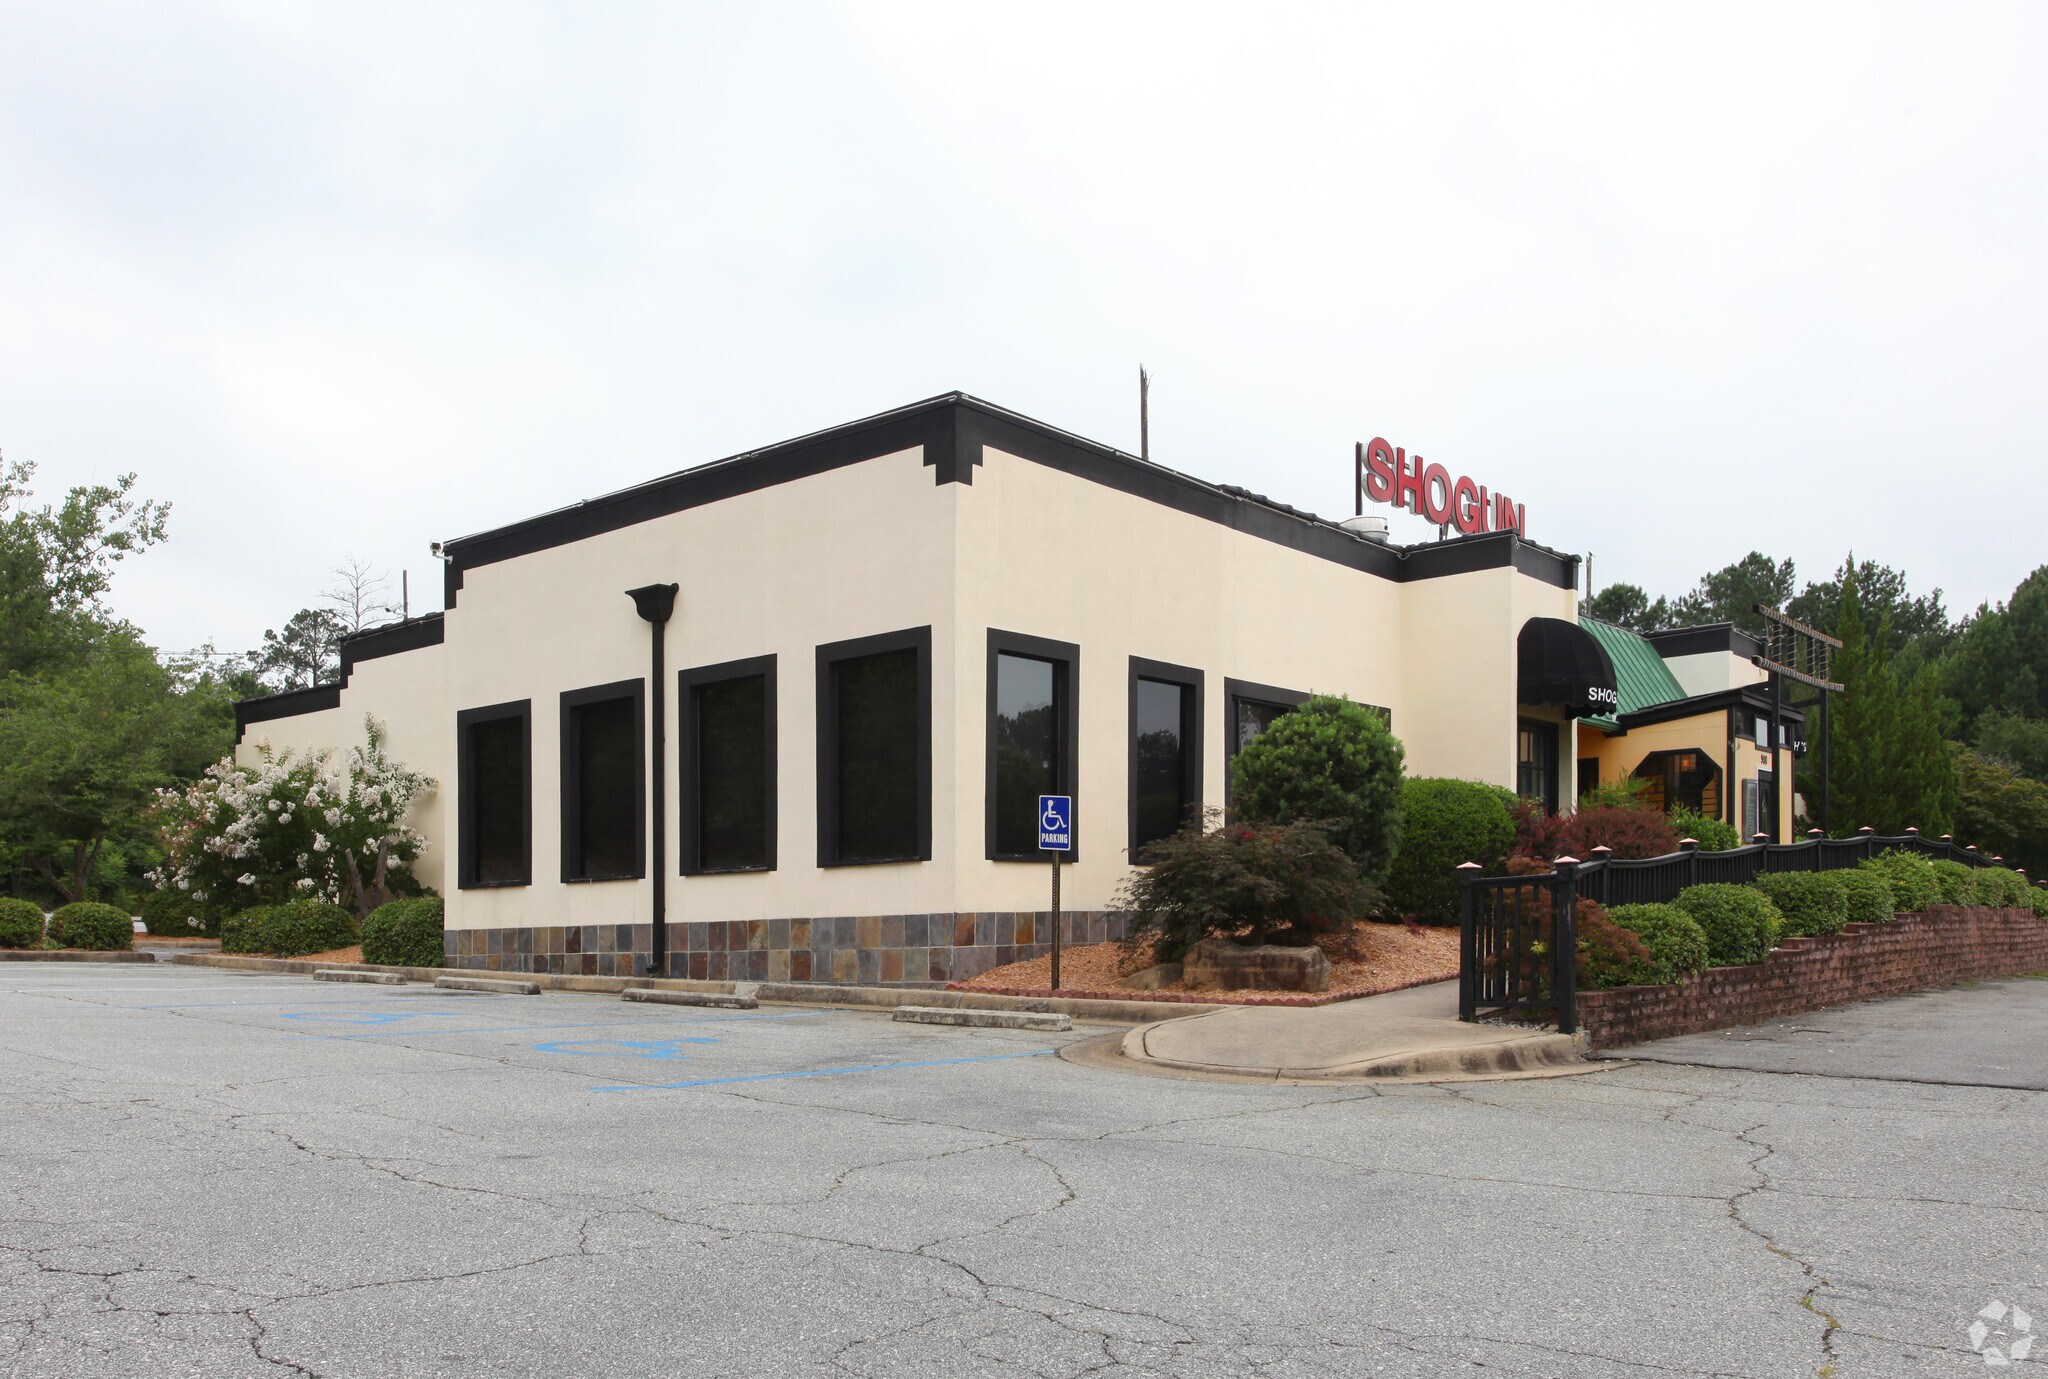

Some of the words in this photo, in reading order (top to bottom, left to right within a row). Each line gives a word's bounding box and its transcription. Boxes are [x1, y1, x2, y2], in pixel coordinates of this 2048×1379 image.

[1362, 436, 1526, 538] SHOGUN
[1588, 686, 1617, 704] SHOG
[1041, 832, 1068, 844] PARKING
